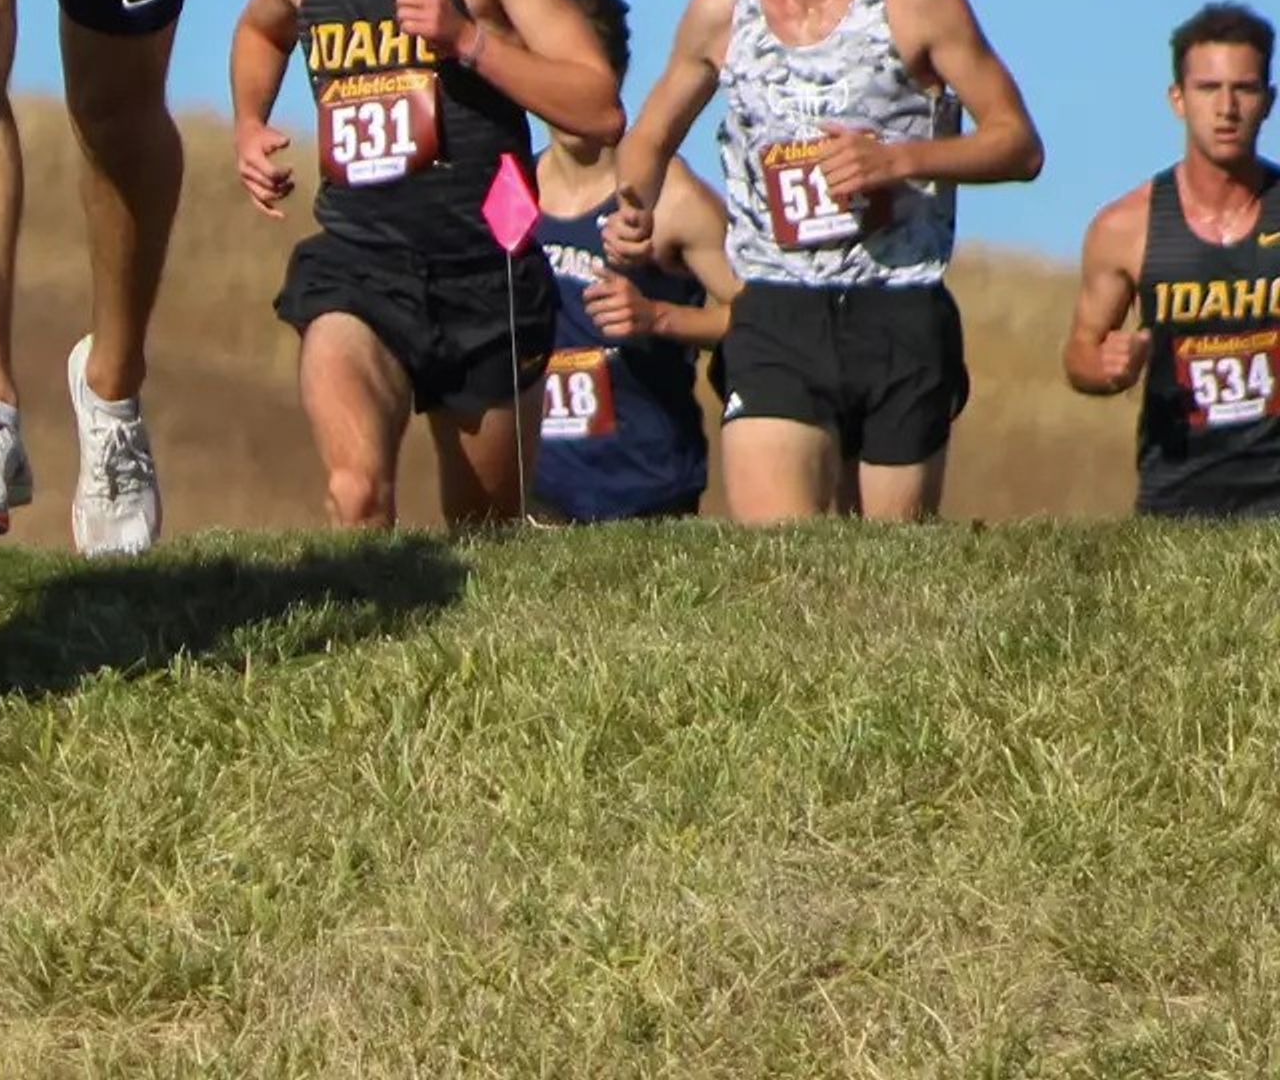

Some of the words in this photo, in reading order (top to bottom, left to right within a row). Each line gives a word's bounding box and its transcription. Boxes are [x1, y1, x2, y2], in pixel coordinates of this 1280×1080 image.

[332, 98, 417, 163] 531
[779, 164, 840, 224] 51
[1190, 352, 1275, 406] 534
